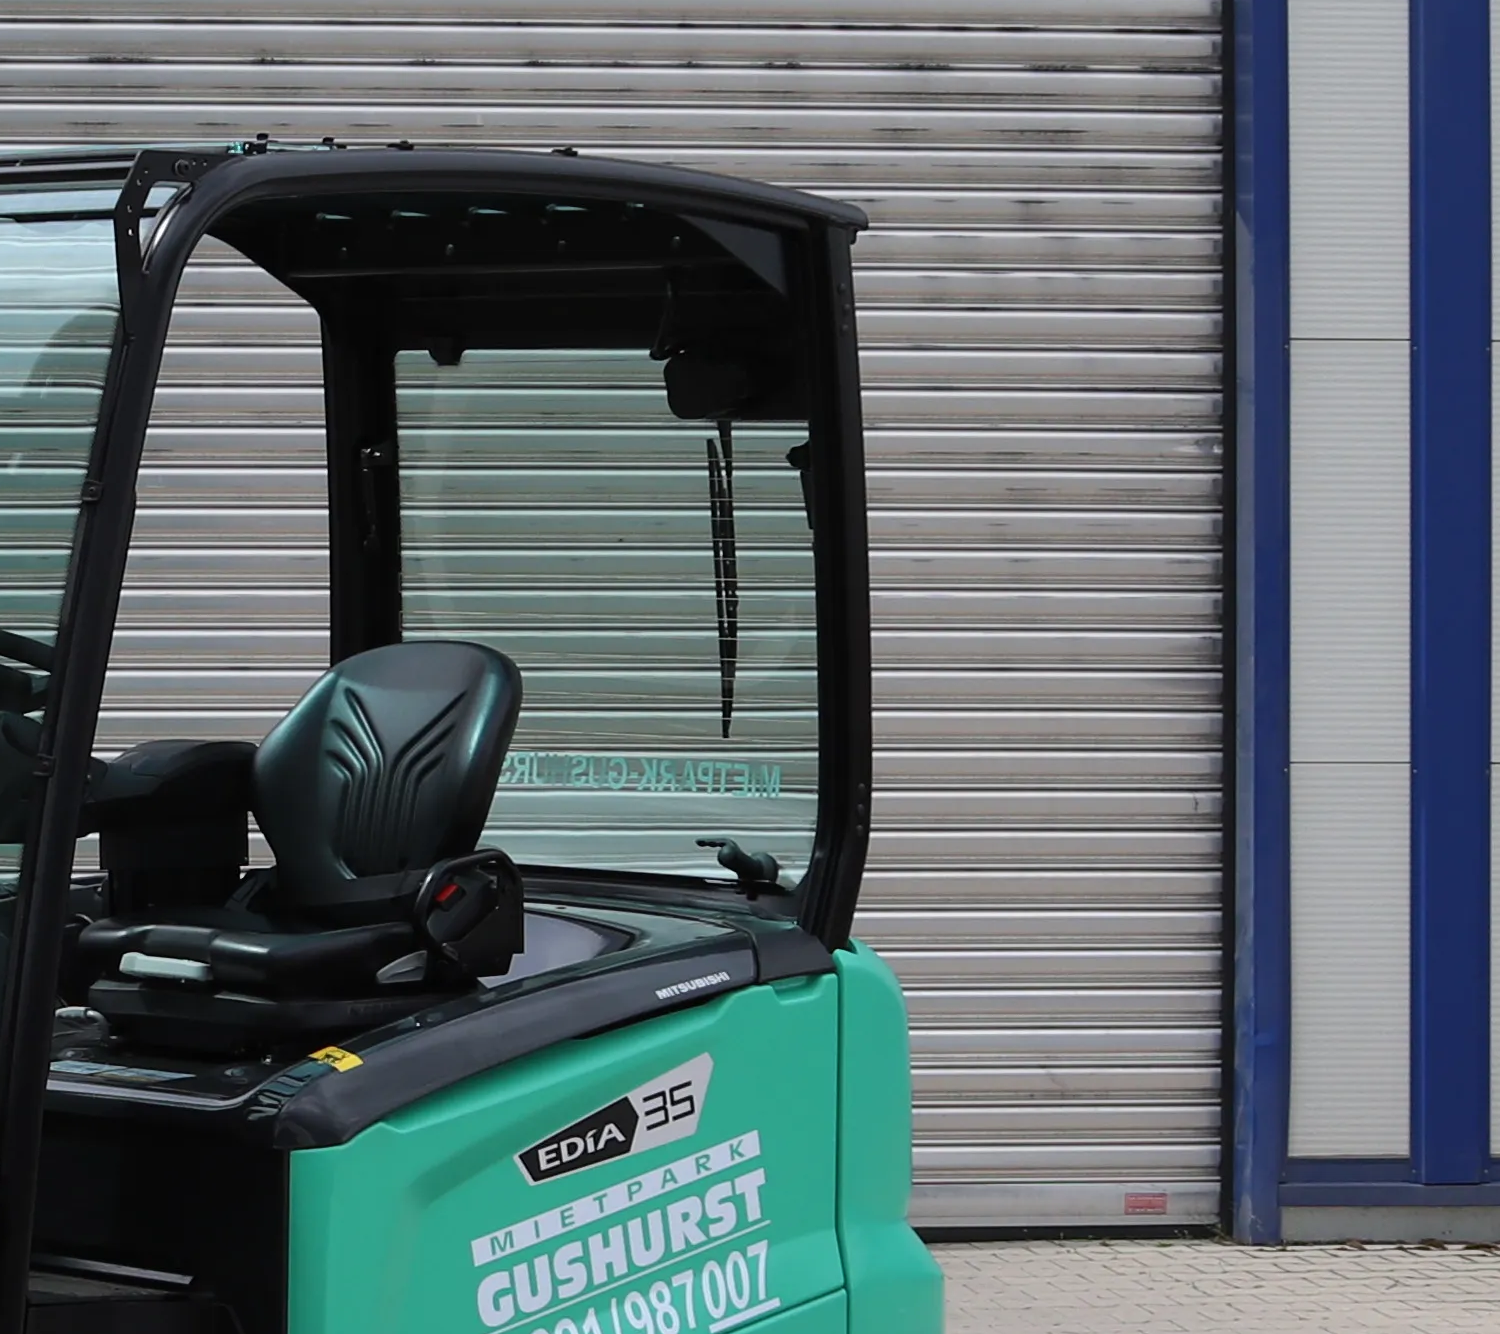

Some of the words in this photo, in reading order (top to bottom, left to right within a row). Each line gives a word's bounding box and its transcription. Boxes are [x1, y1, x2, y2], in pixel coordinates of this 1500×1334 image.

[655, 971, 731, 1000] MITSUBISHI
[642, 1080, 695, 1131] 35
[489, 1139, 746, 1256] MIETPARK
[477, 1167, 766, 1327] GUSHURST
